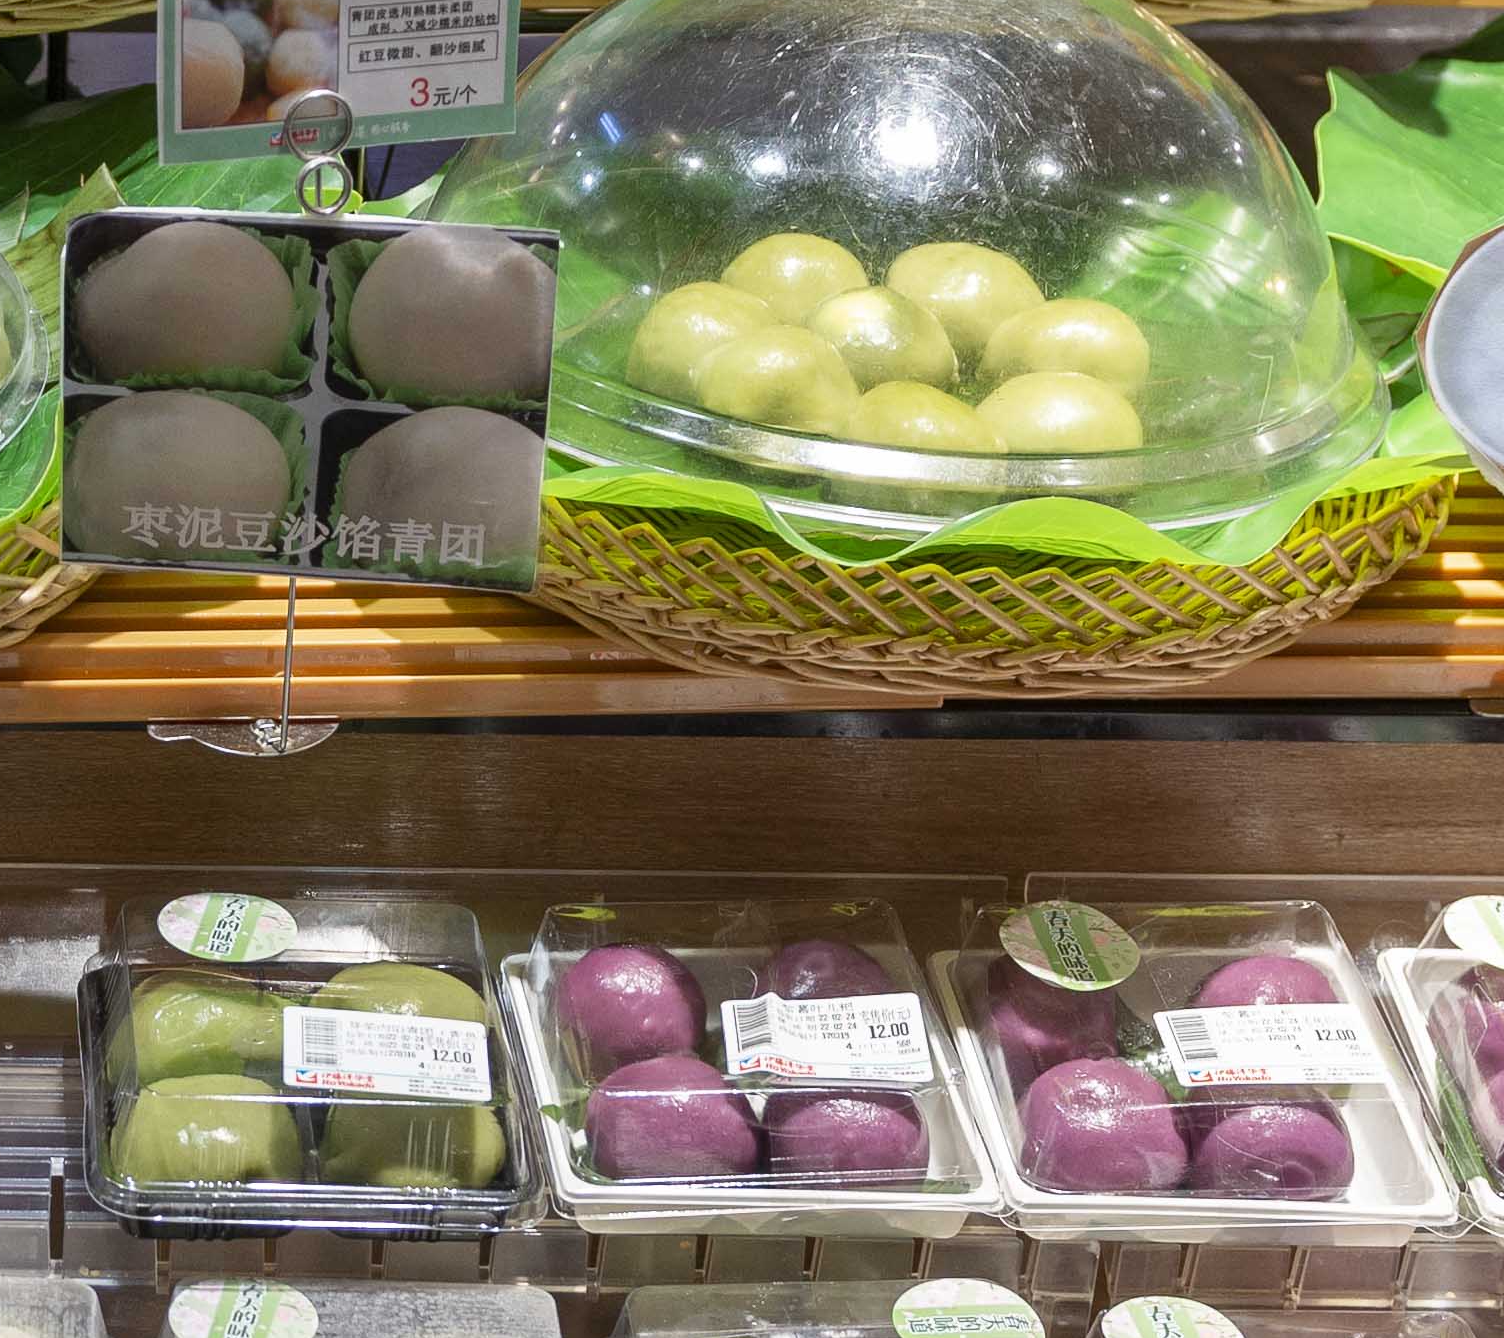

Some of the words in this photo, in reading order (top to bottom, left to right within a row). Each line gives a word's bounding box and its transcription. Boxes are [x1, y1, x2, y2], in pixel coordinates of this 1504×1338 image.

[120, 500, 488, 566] 枣泥豆沙馅青团
[209, 897, 250, 956] 春天的味道
[1045, 909, 1096, 982] 春天的味道
[868, 1022, 910, 1039] 12.00
[1314, 1028, 1357, 1042] 12.00
[432, 1048, 473, 1065] 12.00
[908, 1313, 1030, 1335] 春天的味道
